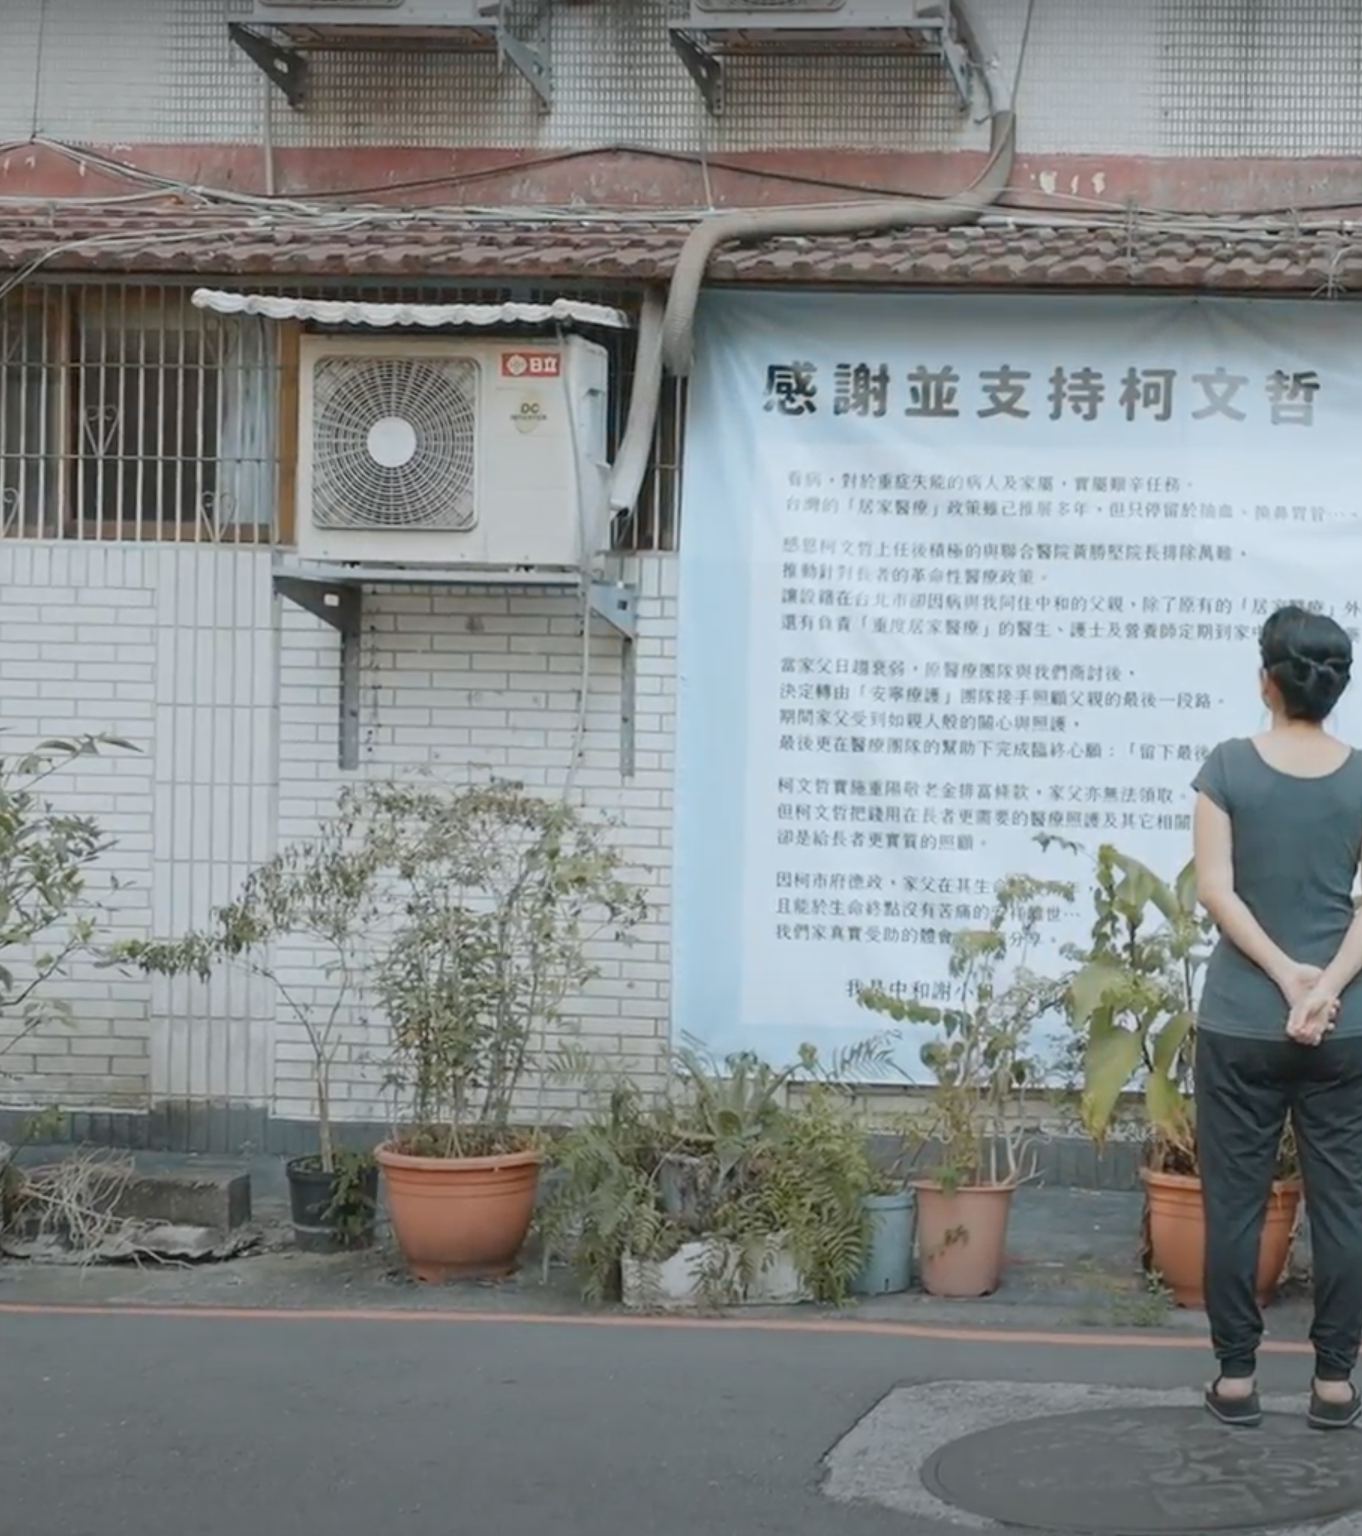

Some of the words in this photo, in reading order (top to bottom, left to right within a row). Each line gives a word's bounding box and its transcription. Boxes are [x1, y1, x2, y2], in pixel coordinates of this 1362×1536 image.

[529, 357, 558, 373] 日立
[762, 361, 1322, 426] 感謝並支持柯文哲
[521, 403, 540, 414] DC
